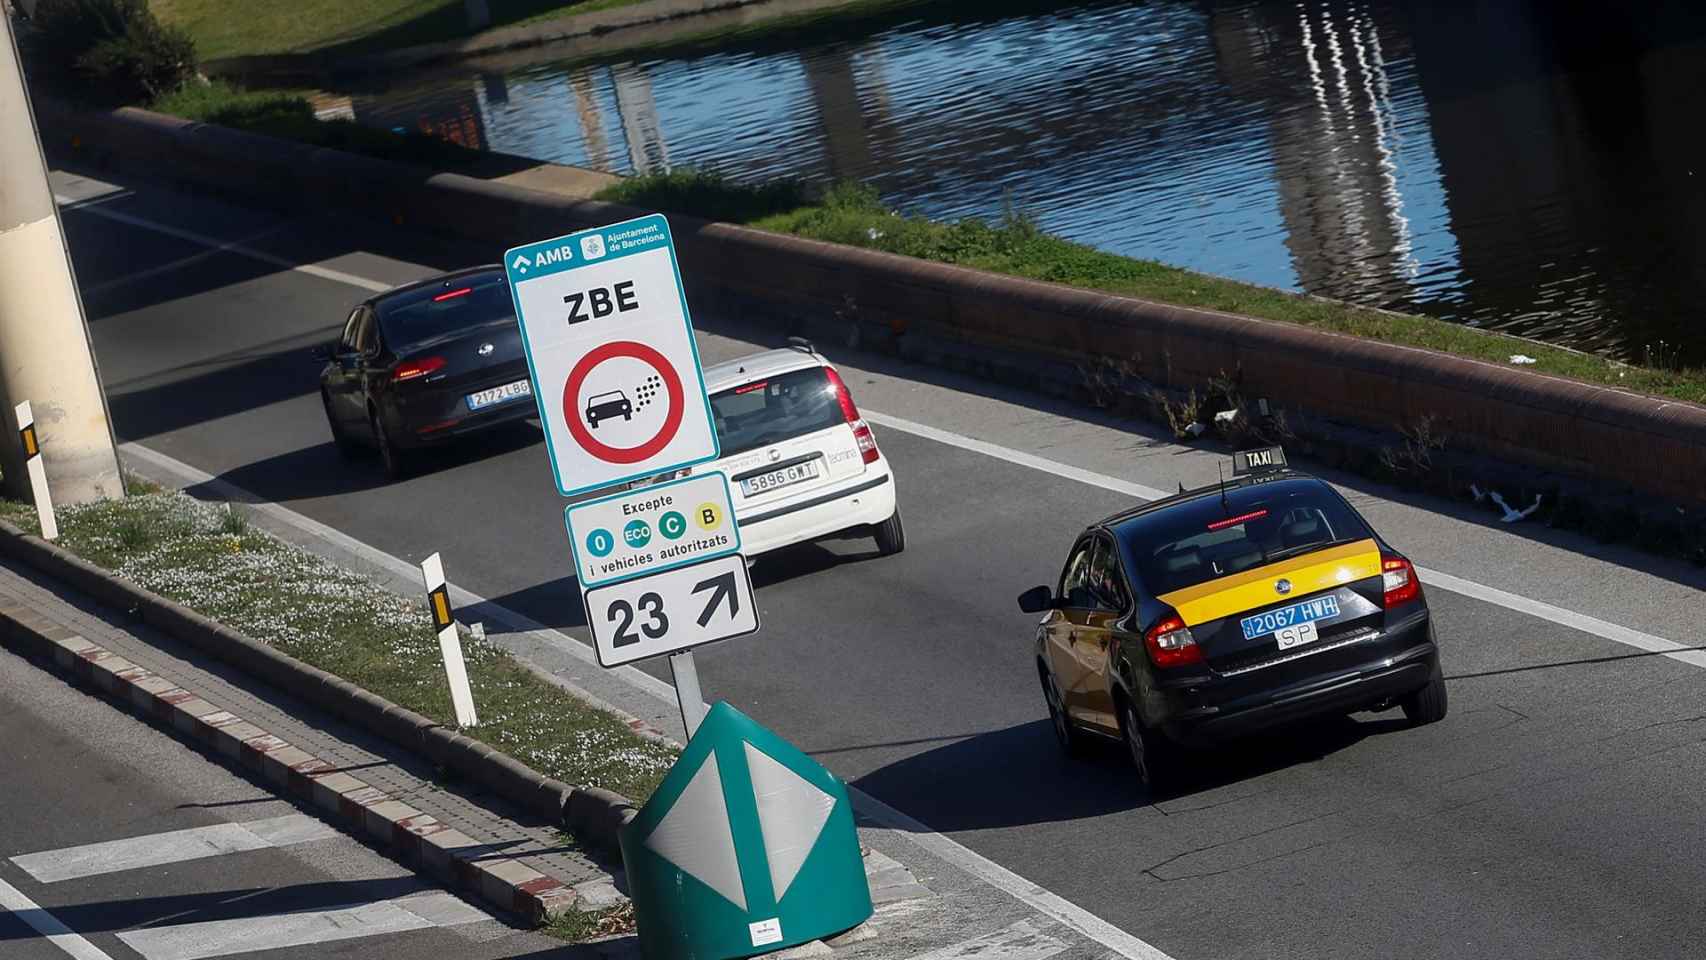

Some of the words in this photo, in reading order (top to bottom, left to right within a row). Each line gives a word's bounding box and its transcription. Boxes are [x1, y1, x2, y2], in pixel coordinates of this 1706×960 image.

[608, 224, 658, 243] Ajuntament
[621, 233, 665, 249] Barcelona
[535, 246, 574, 268] AMB
[563, 279, 640, 325] ZBE
[1246, 450, 1272, 467] TAXI
[750, 472, 785, 491] 5896
[622, 495, 673, 516] Excepte
[594, 535, 606, 551] 0
[625, 526, 651, 542] ECO
[666, 517, 680, 533] C
[702, 508, 715, 525] B
[589, 566, 595, 576] i
[601, 552, 653, 575] vehicles
[660, 534, 728, 560] autoritzats
[607, 591, 670, 649] 23
[1254, 607, 1296, 633] 2067
[1301, 598, 1335, 620] HWH
[1281, 624, 1311, 646] SP
